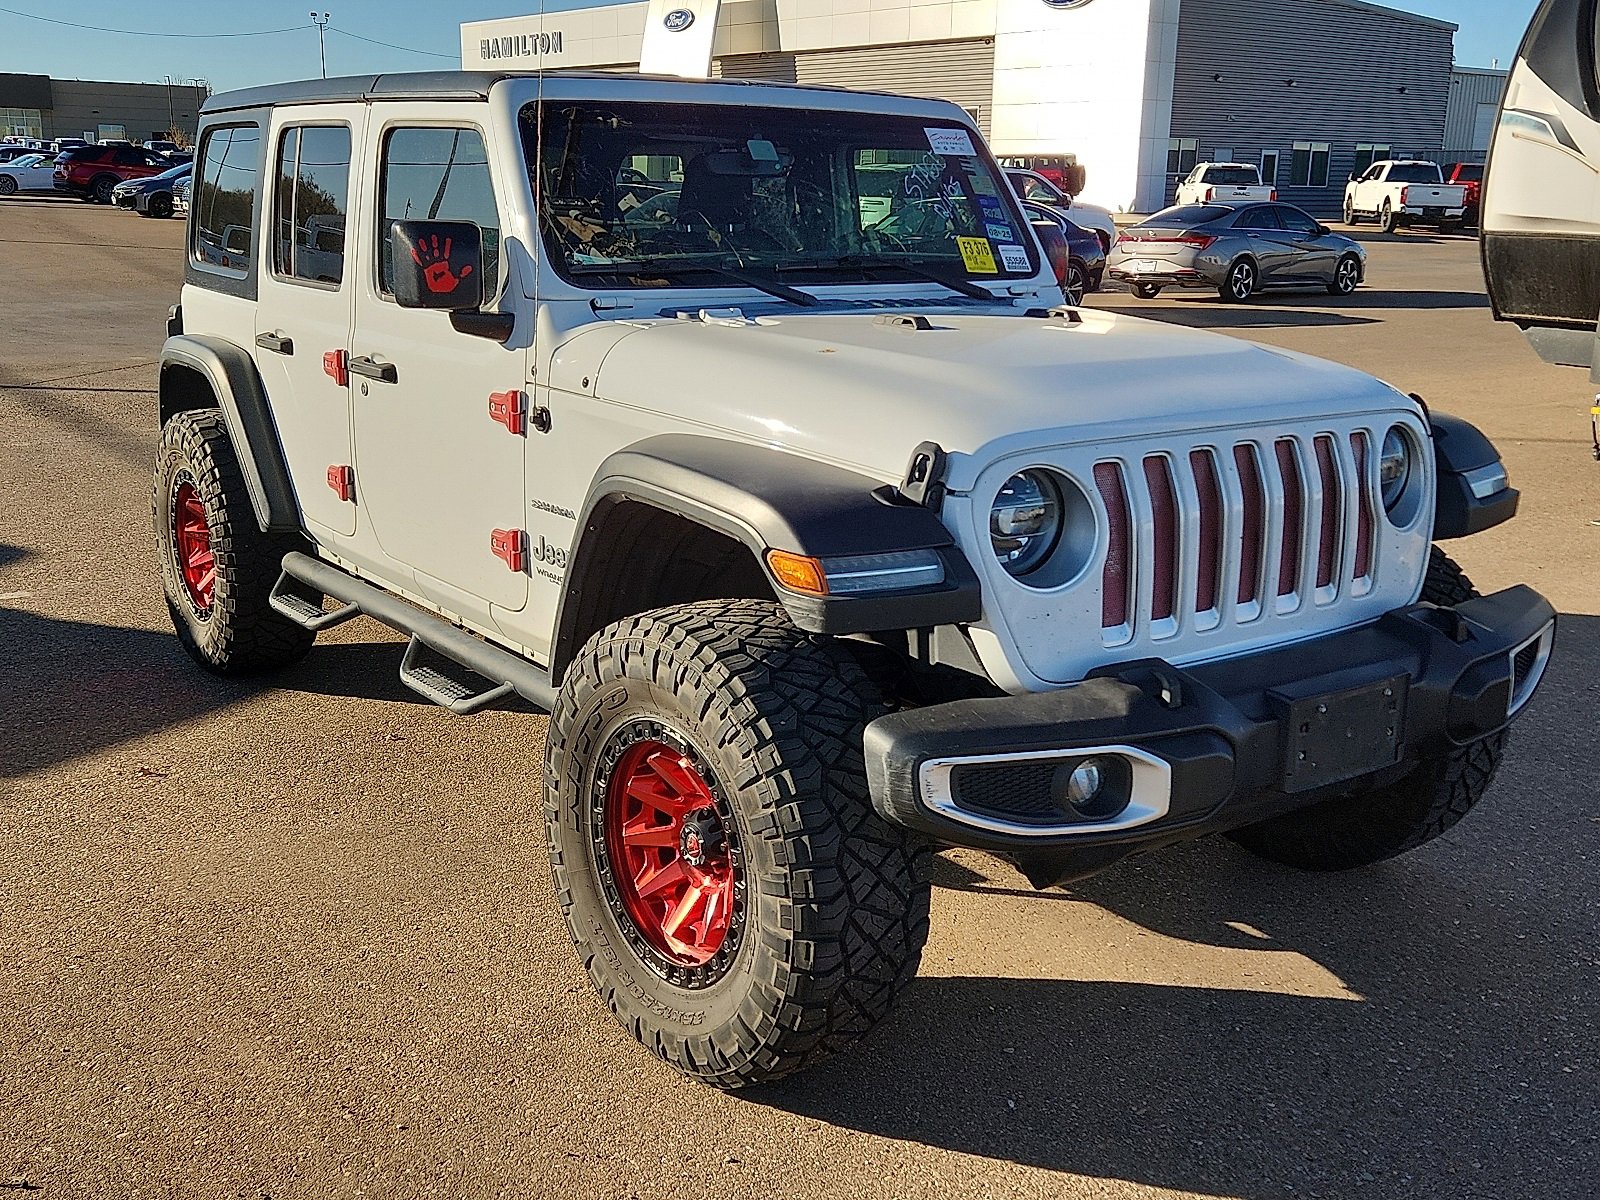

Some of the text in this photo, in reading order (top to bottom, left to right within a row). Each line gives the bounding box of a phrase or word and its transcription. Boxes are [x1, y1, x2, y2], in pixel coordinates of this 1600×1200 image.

[666, 12, 686, 27] Ford
[480, 31, 562, 59] HAMILTON
[533, 534, 570, 569] Jee
